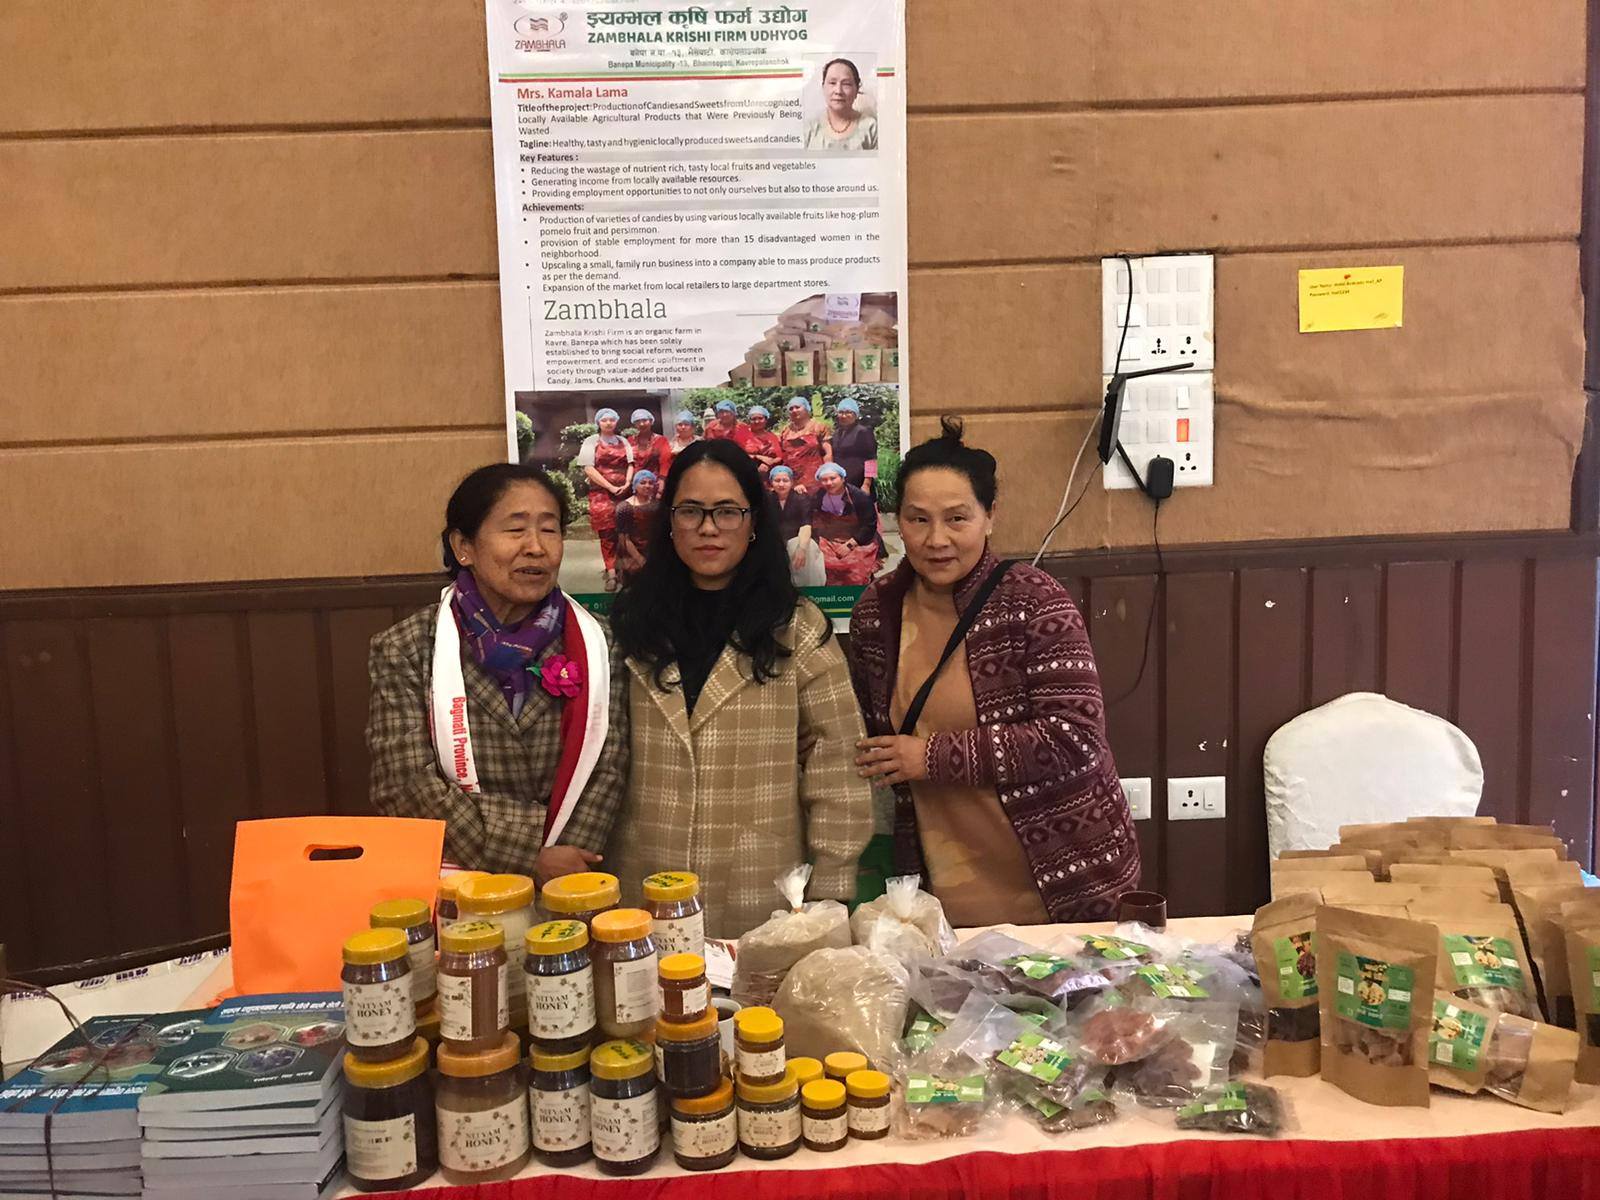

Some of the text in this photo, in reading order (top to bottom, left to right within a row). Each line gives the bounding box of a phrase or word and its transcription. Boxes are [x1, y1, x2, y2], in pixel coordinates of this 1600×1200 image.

[668, 6, 708, 28] कृषि
[714, 7, 752, 24] फर्म
[758, 5, 808, 24] उद्योग
[588, 29, 808, 44] ZAMBHALA KRISHI FIRM UDHYOG
[517, 87, 628, 99] Mrs. Kamala Lama
[518, 110, 802, 124] Locally Available Agricultural Products that Were Previously Being
[520, 153, 573, 162] Key Features
[531, 162, 816, 176] Reducing the wastage of nutrient rich, tasty local fruits and vegetables
[532, 175, 742, 188] Generating income from locally available resources.
[532, 189, 570, 199] Providing
[572, 188, 624, 198] employment
[626, 187, 682, 198] opportunities
[684, 187, 692, 195] to
[710, 186, 727, 195] only
[729, 185, 767, 194] ourselves
[768, 185, 782, 193] but
[784, 185, 800, 193] also
[812, 184, 835, 192] those
[836, 184, 866, 192] around
[522, 203, 584, 212] Achievements:
[539, 211, 879, 225] Production of varieties of candies by using various locally available fruits like hog-plum
[540, 226, 658, 237] pomelo fruit and persimmon.
[540, 238, 578, 248] provision
[582, 238, 592, 246] of
[595, 238, 620, 246] stable
[624, 236, 675, 246] employment
[679, 236, 692, 244] for
[721, 235, 740, 243] than
[758, 234, 816, 244] disadvantaged
[541, 250, 600, 259] neighborhood.
[541, 261, 581, 270] Upscaling
[589, 260, 614, 270] small,
[615, 259, 640, 269] family
[658, 259, 693, 268] business
[719, 258, 756, 267] company
[758, 258, 775, 266] able
[810, 257, 843, 266] produce
[844, 256, 880, 265] products
[553, 273, 567, 282] per
[569, 272, 583, 280] the
[585, 272, 621, 280] demand.
[543, 284, 584, 293] Expansion
[586, 283, 596, 291] of
[597, 283, 611, 291] the
[613, 282, 642, 290] market
[644, 282, 663, 290] from
[665, 281, 684, 290] local
[686, 281, 720, 289] retailers
[731, 281, 752, 290] large
[754, 280, 802, 289] department
[803, 279, 830, 287] stores.
[544, 298, 667, 320] Zambhala
[450, 696, 466, 735] Bagmati
[357, 1008, 392, 1017] HONEY
[536, 1002, 568, 1010] HONEY
[465, 1135, 501, 1148] HONEY
